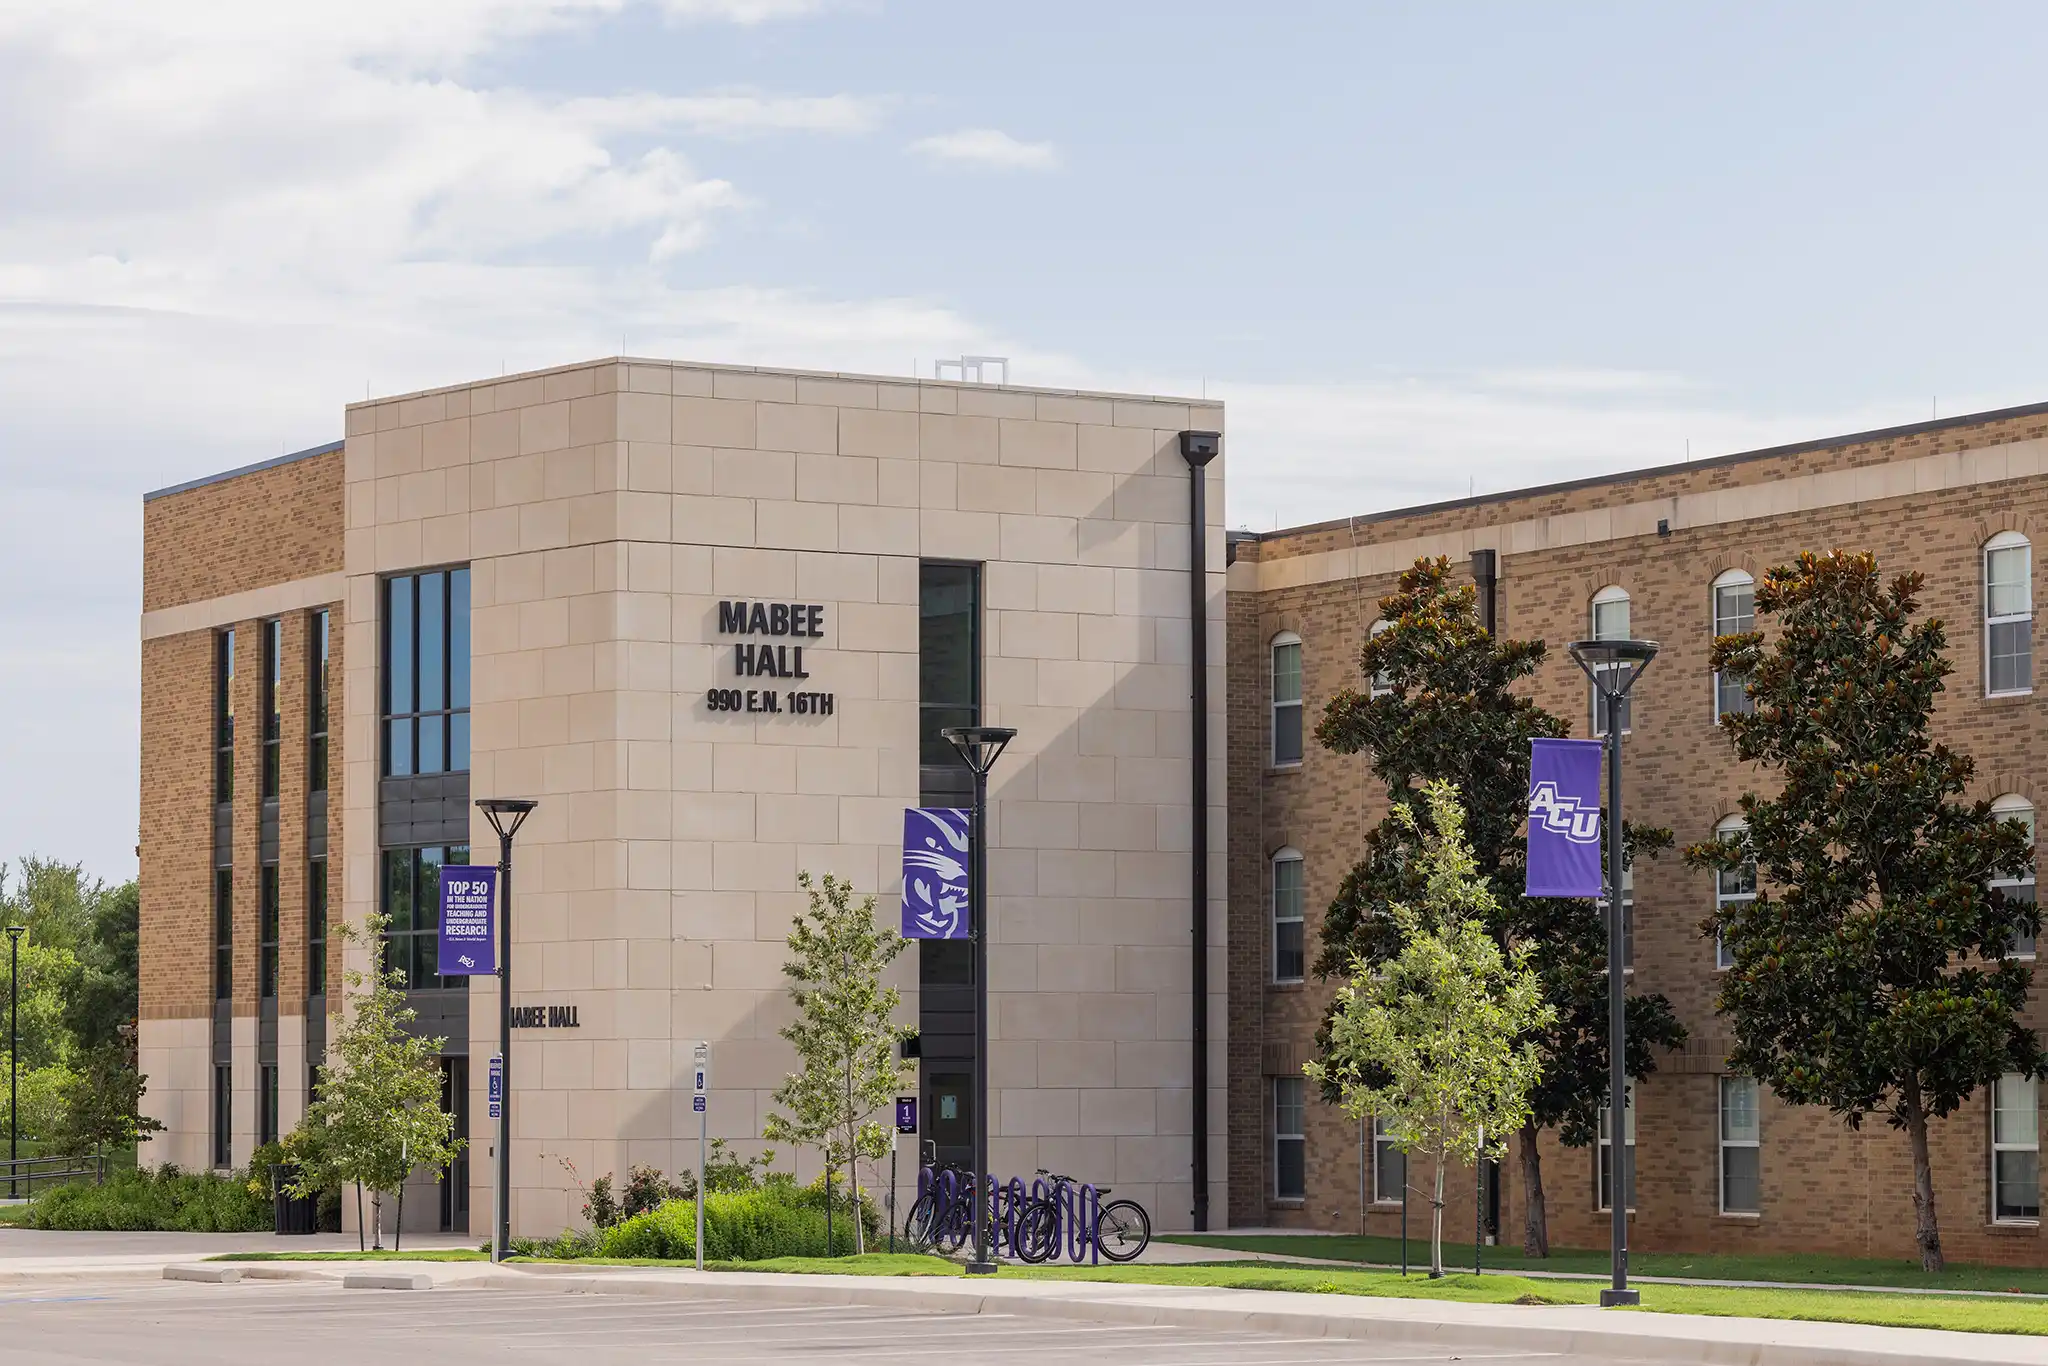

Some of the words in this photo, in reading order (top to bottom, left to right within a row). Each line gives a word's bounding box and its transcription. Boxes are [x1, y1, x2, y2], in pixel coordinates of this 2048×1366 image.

[719, 601, 824, 637] MABEE
[735, 643, 809, 678] HALL
[707, 689, 742, 711] 990
[746, 690, 782, 713] E.N.
[787, 692, 834, 715] 16TH
[1529, 784, 1600, 841] ACU
[448, 881, 470, 895] TOP
[472, 881, 488, 895] 50
[446, 925, 487, 936] RESEARCH
[548, 1006, 580, 1028] HALL
[903, 1105, 909, 1117] 1
